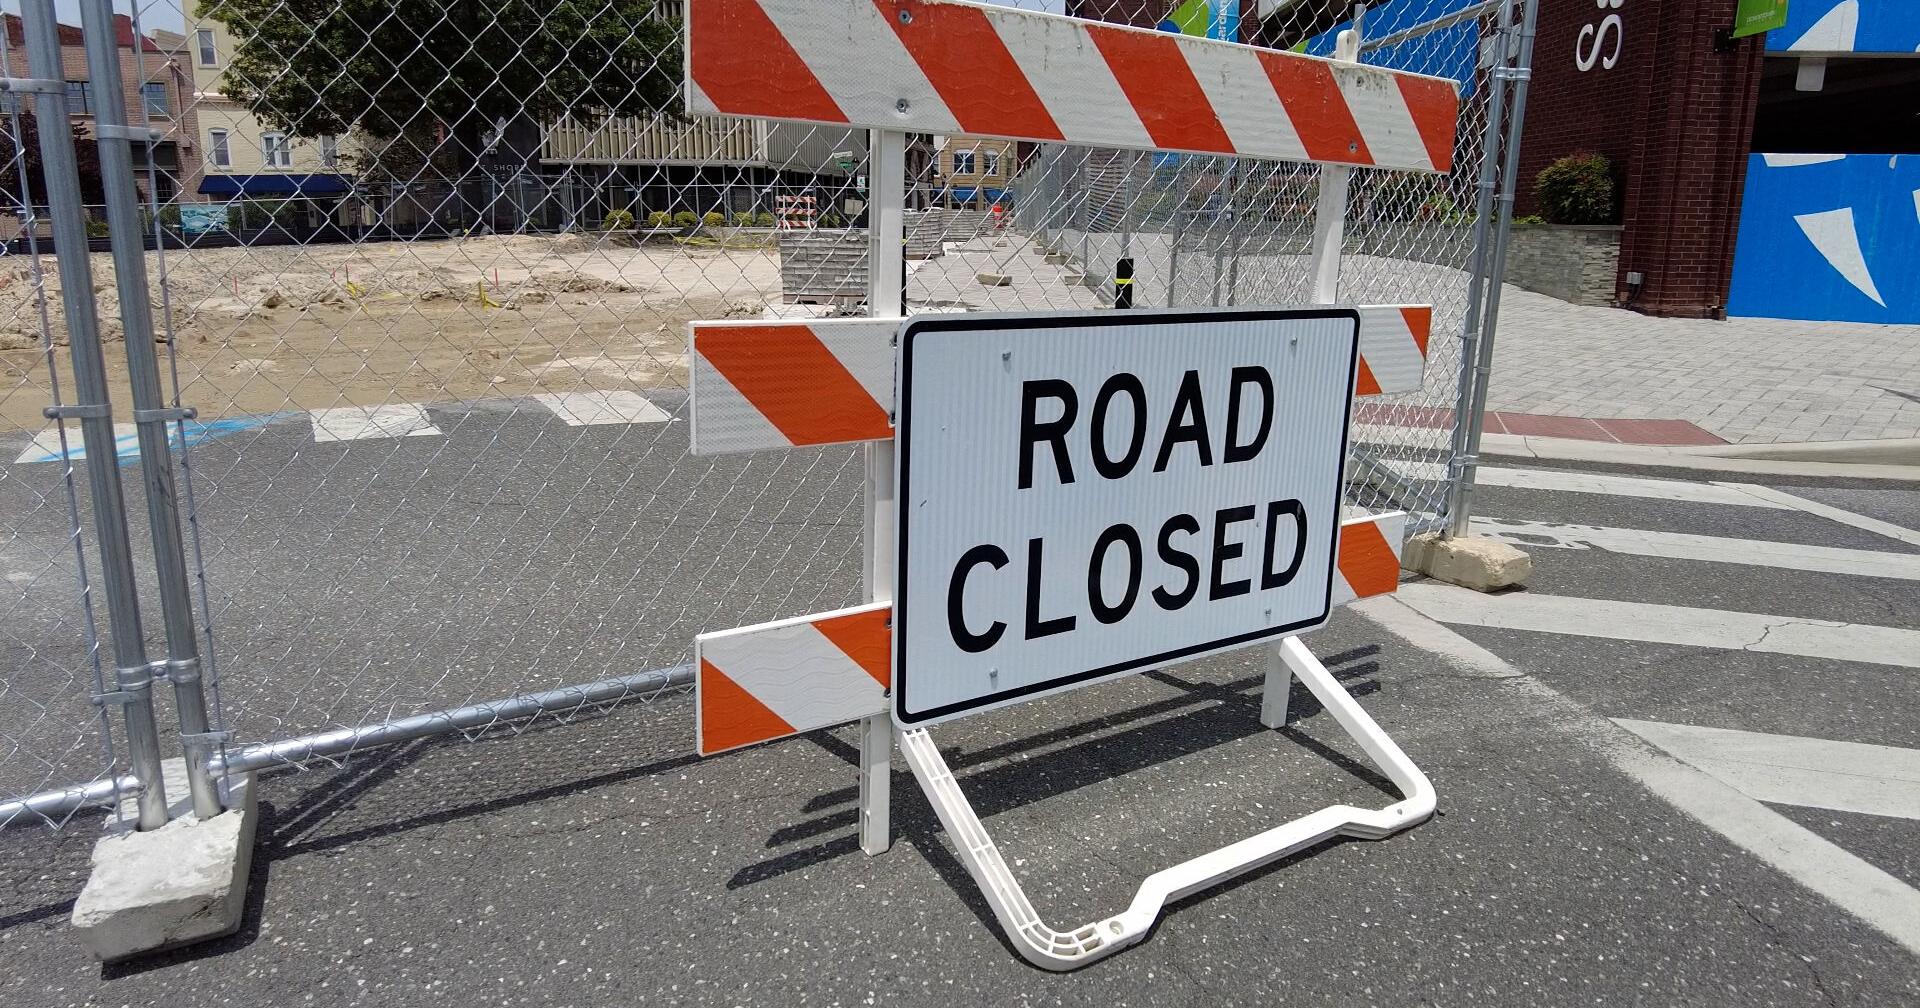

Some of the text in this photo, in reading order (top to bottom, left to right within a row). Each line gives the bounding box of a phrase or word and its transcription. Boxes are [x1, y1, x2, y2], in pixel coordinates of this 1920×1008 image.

[1575, 0, 1624, 72] S
[1017, 365, 1276, 490] ROAD
[947, 498, 1309, 654] CLOSED
